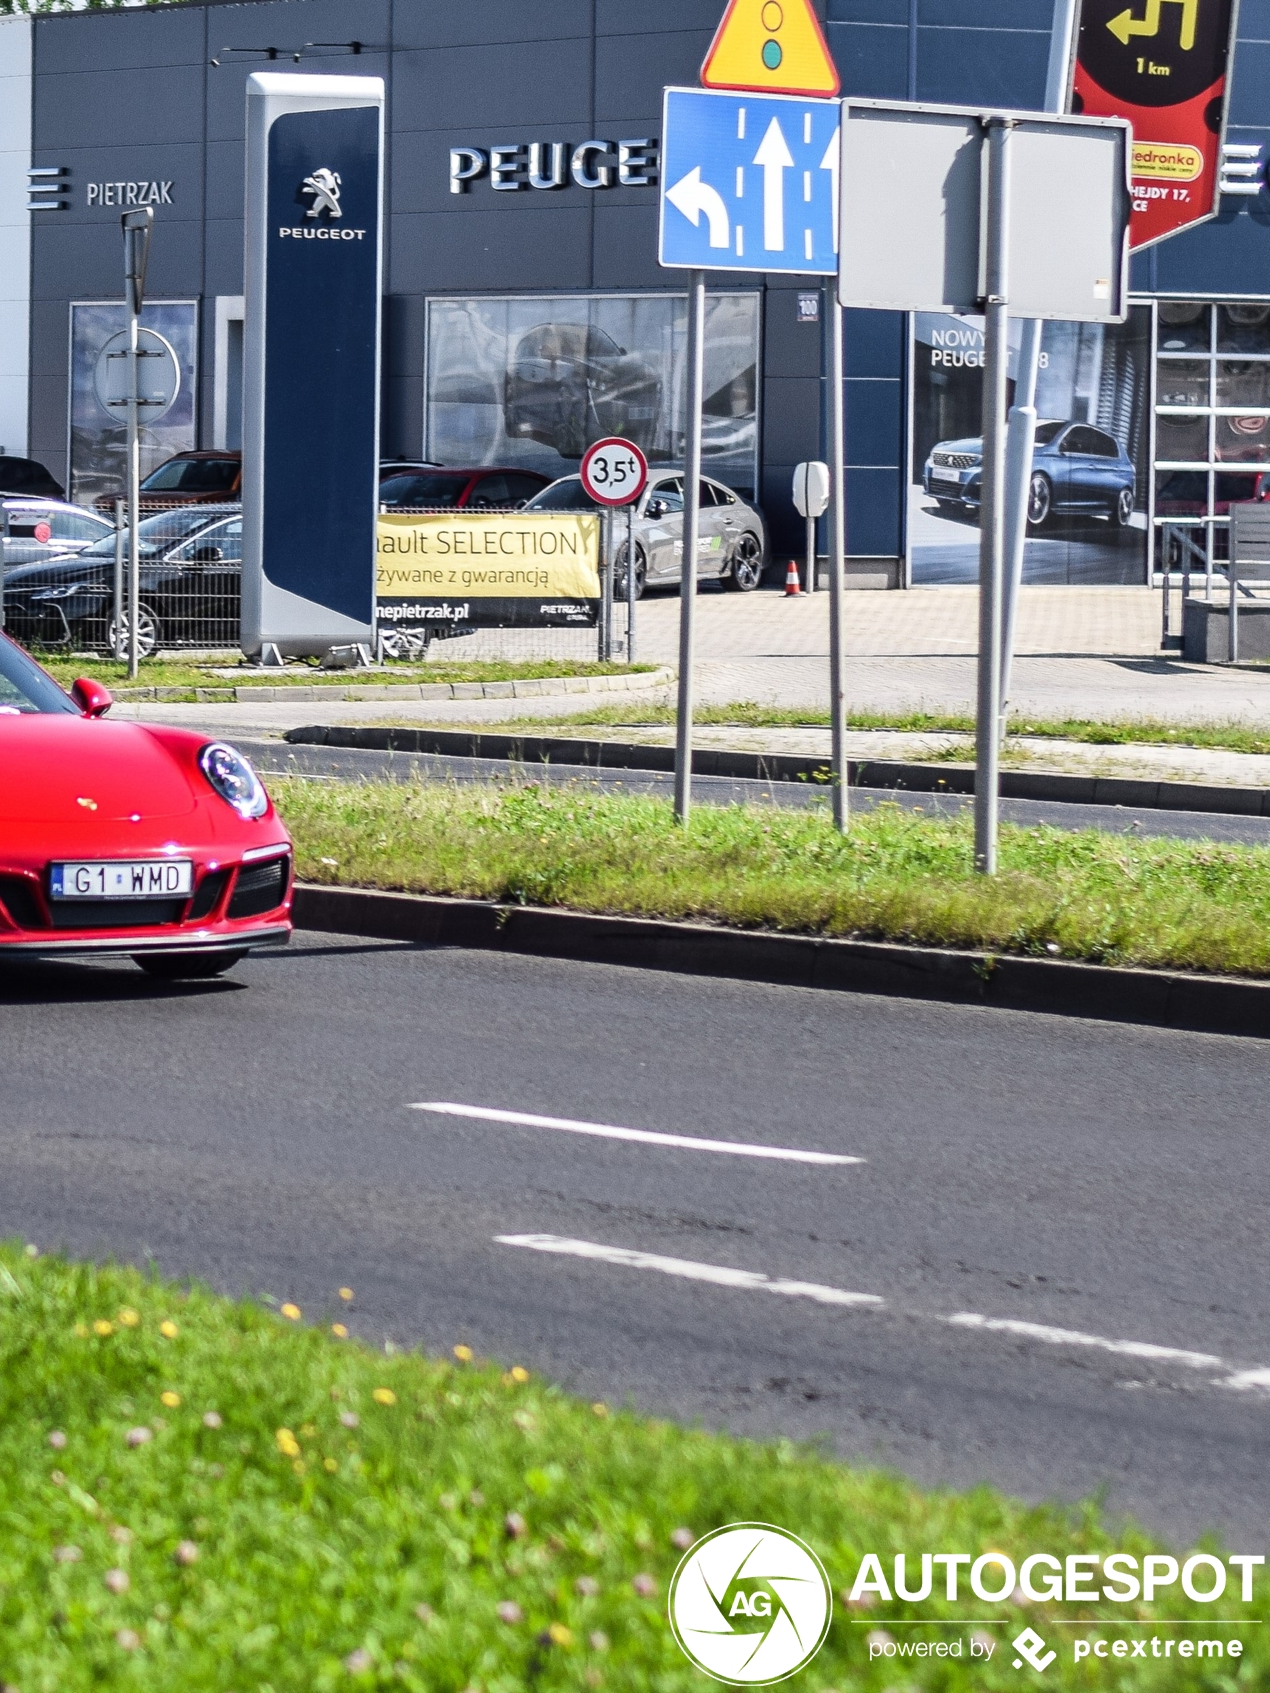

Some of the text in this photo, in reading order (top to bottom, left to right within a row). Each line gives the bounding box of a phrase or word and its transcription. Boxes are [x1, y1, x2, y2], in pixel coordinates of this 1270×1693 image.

[1136, 57, 1170, 76] 1 km
[449, 138, 661, 194] PEUGE
[87, 181, 174, 206] PIETRZAK
[1130, 186, 1191, 203] HEJDY 17,
[1132, 200, 1149, 212] CE
[279, 227, 367, 241] PEUGEOT
[436, 531, 577, 555] SELECTION
[375, 565, 549, 588] żywane z gwarancją
[375, 602, 470, 621] nepietrzak.pl
[75, 866, 180, 893] G1 WMD
